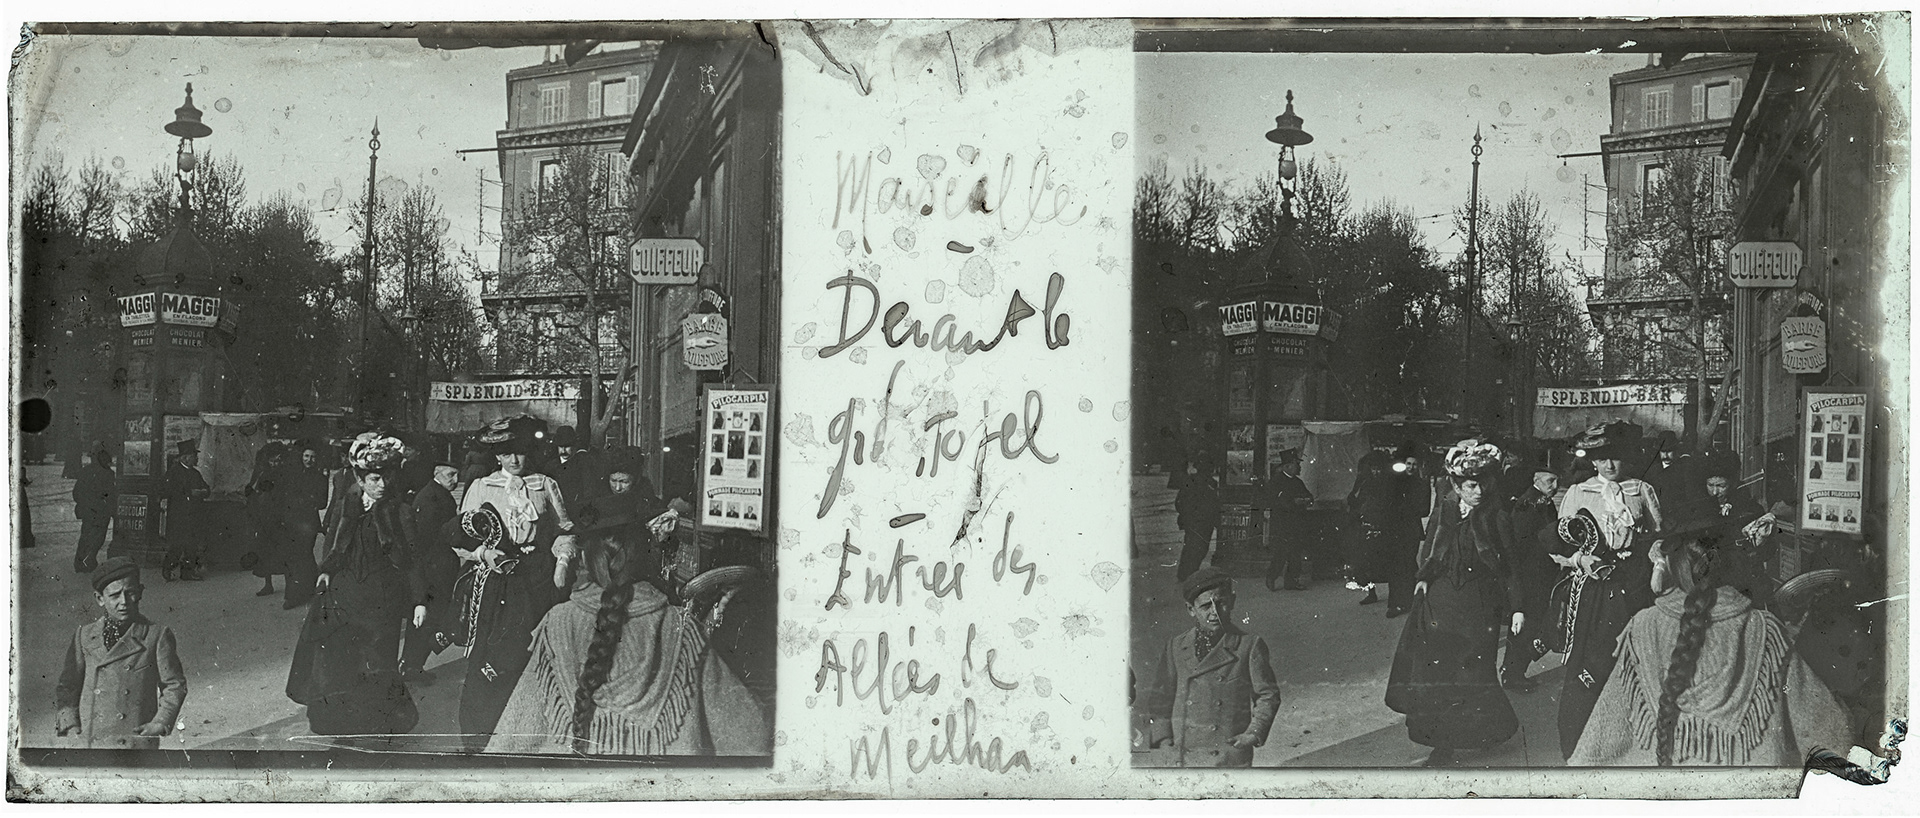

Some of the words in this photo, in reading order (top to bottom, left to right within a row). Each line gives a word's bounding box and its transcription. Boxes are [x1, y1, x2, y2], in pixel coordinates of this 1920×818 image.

[631, 247, 699, 277] COIFFEUR
[1731, 250, 1799, 280] COIFFEUR
[119, 295, 155, 316] MAGGI
[163, 294, 219, 317] MAGGI
[1220, 303, 1256, 325] MAGGI
[1264, 303, 1320, 325] MAGGI
[132, 329, 155, 338] CHOCOLAT
[169, 329, 205, 339] CHOCOLAT
[1782, 322, 1823, 339] BARBE
[133, 338, 153, 346] MENIER
[171, 338, 203, 348] MENIER
[1271, 338, 1307, 347] CHOCOLAT
[1273, 347, 1304, 355] MENIER
[713, 393, 766, 409] PILOCARPIA
[1811, 396, 1865, 412] PILOCARPIA
[731, 486, 761, 495] PILOCARPIA
[1808, 490, 1831, 500] POMMADE
[1831, 490, 1861, 498] PILOCARPIA
[117, 506, 147, 517] CHOCOLAT
[117, 519, 143, 530] MENIER
[1221, 515, 1250, 526] CHOCOLAT
